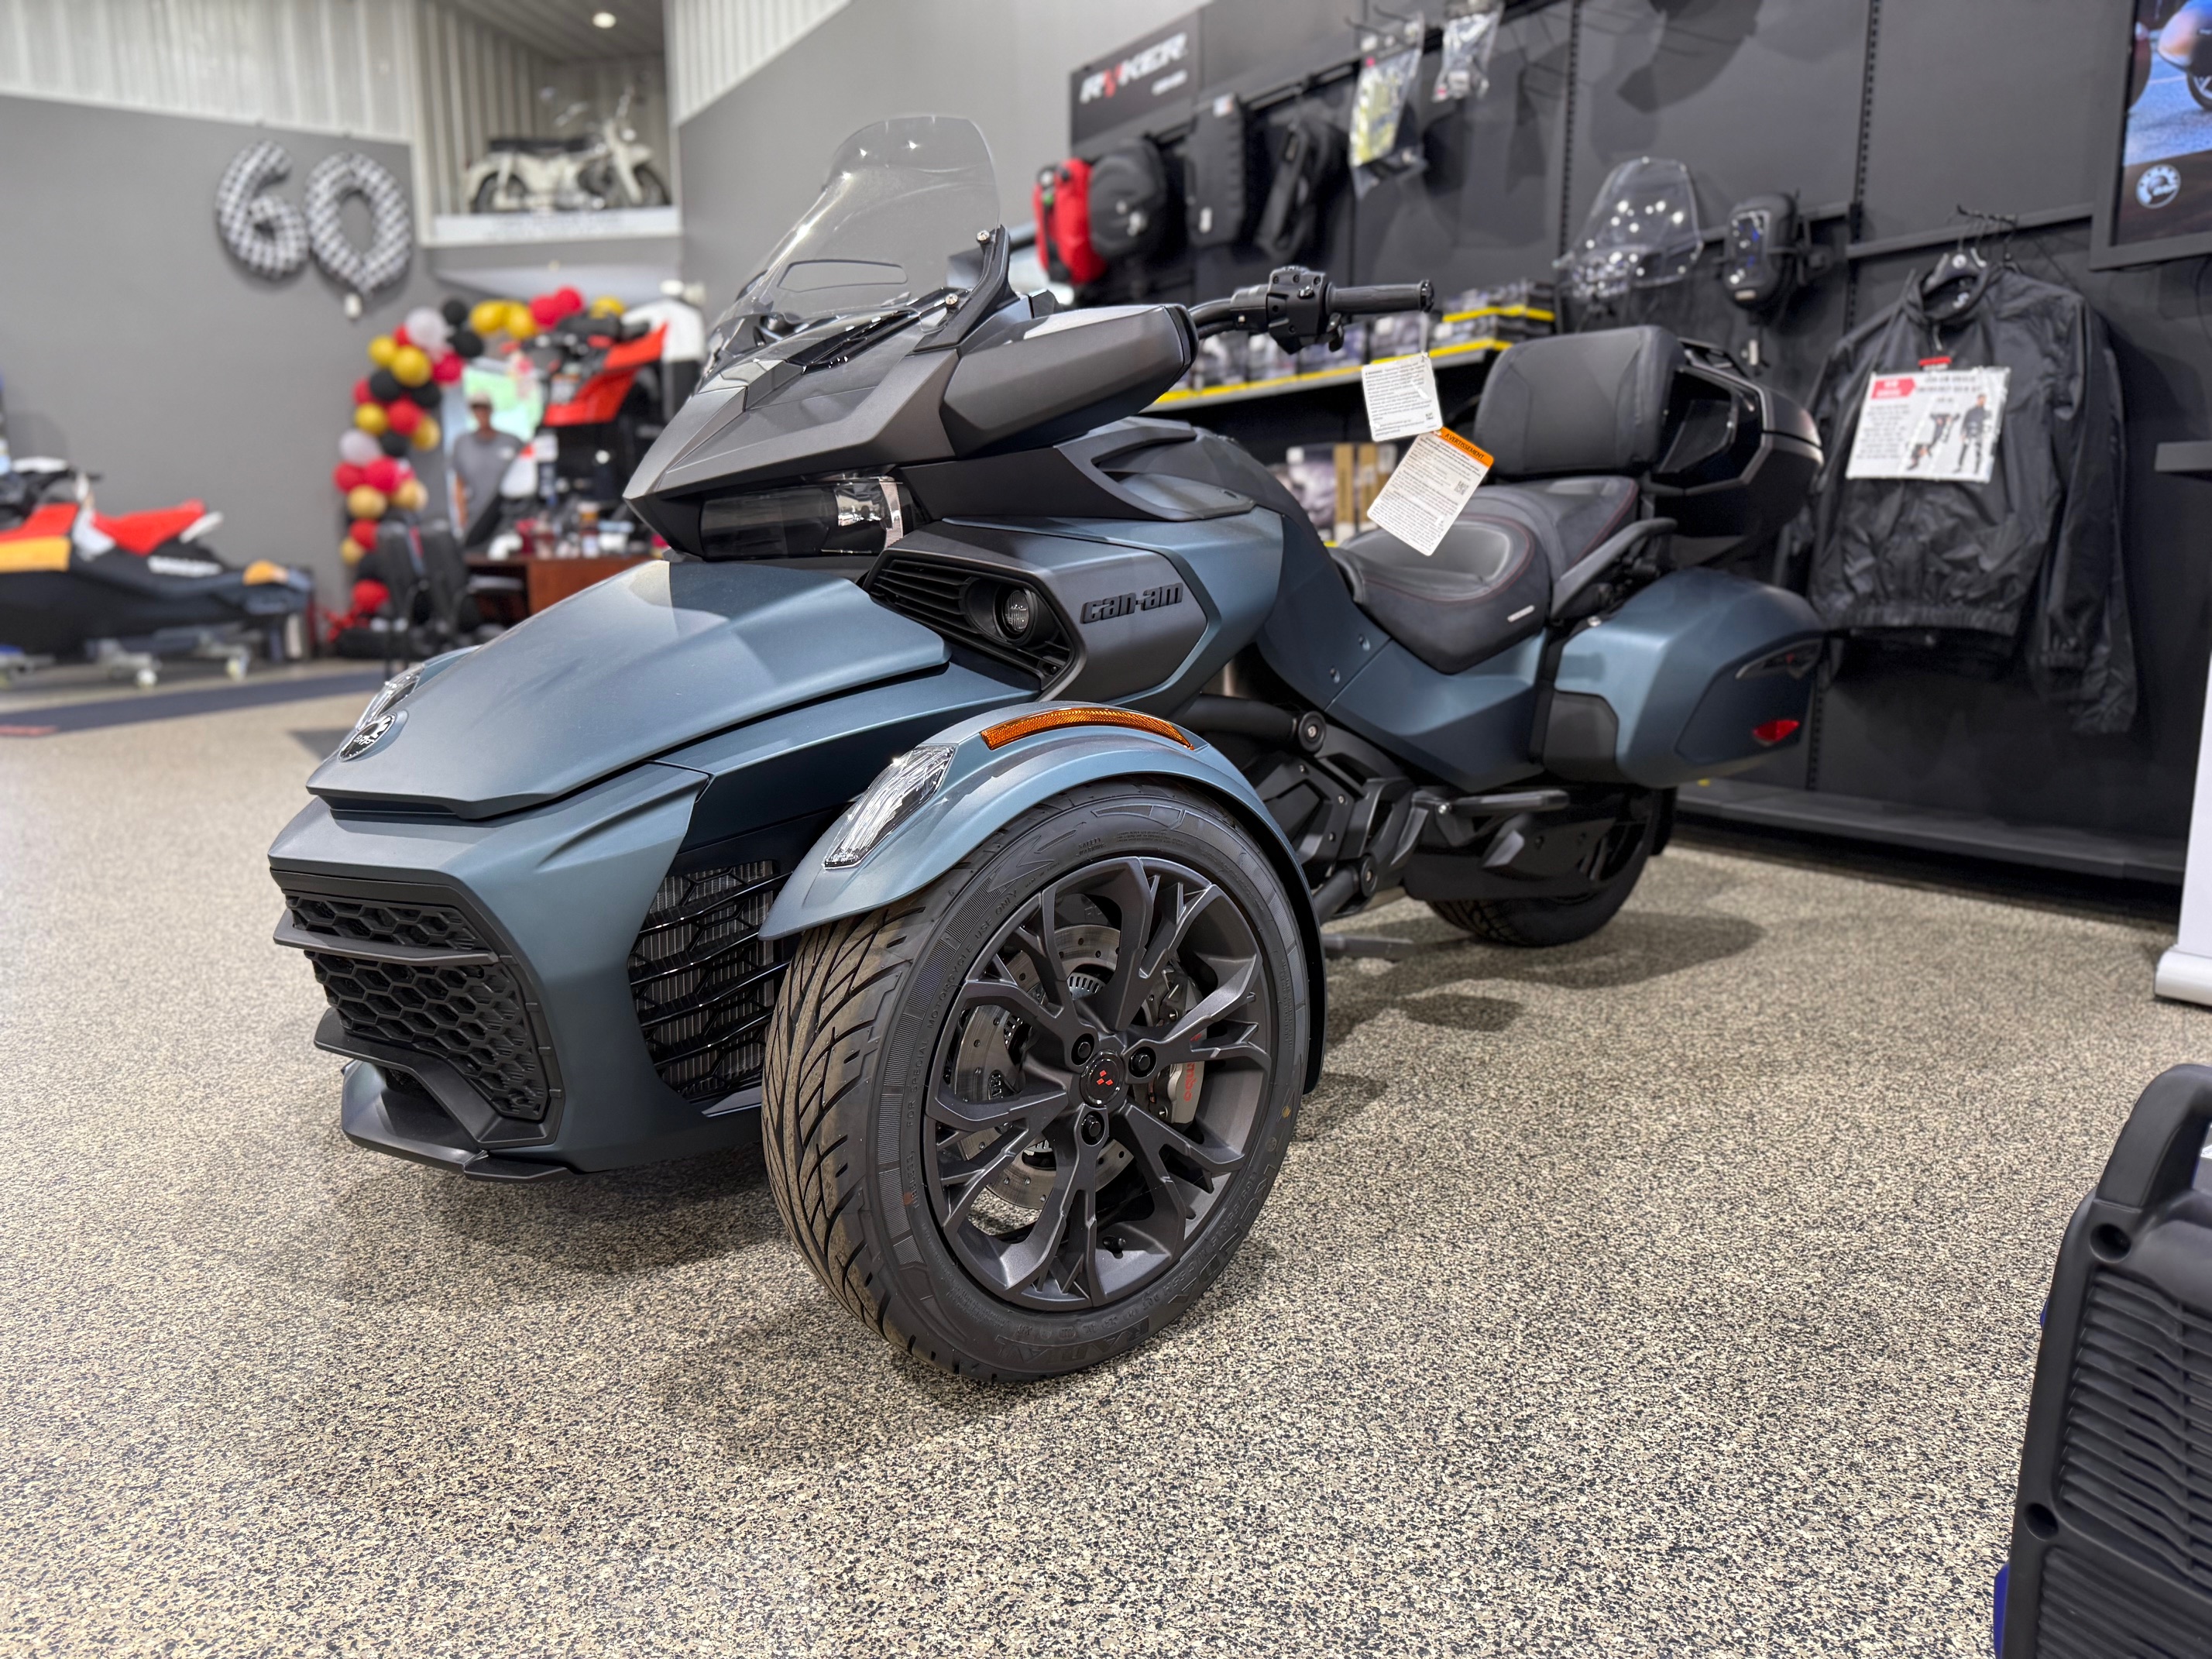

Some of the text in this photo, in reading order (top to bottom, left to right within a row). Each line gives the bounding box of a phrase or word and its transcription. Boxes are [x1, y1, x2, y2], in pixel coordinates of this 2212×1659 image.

[1444, 433, 1485, 459] AVERTISSEMENT
[1080, 582, 1183, 624] can-am
[995, 889, 1018, 915] ONLY
[975, 918, 993, 939] USE
[928, 943, 974, 1029] MOTORCYCLE
[910, 1041, 928, 1092] SPECIAL
[906, 1100, 915, 1128] FOR
[1168, 1163, 1276, 1304] KENDA
